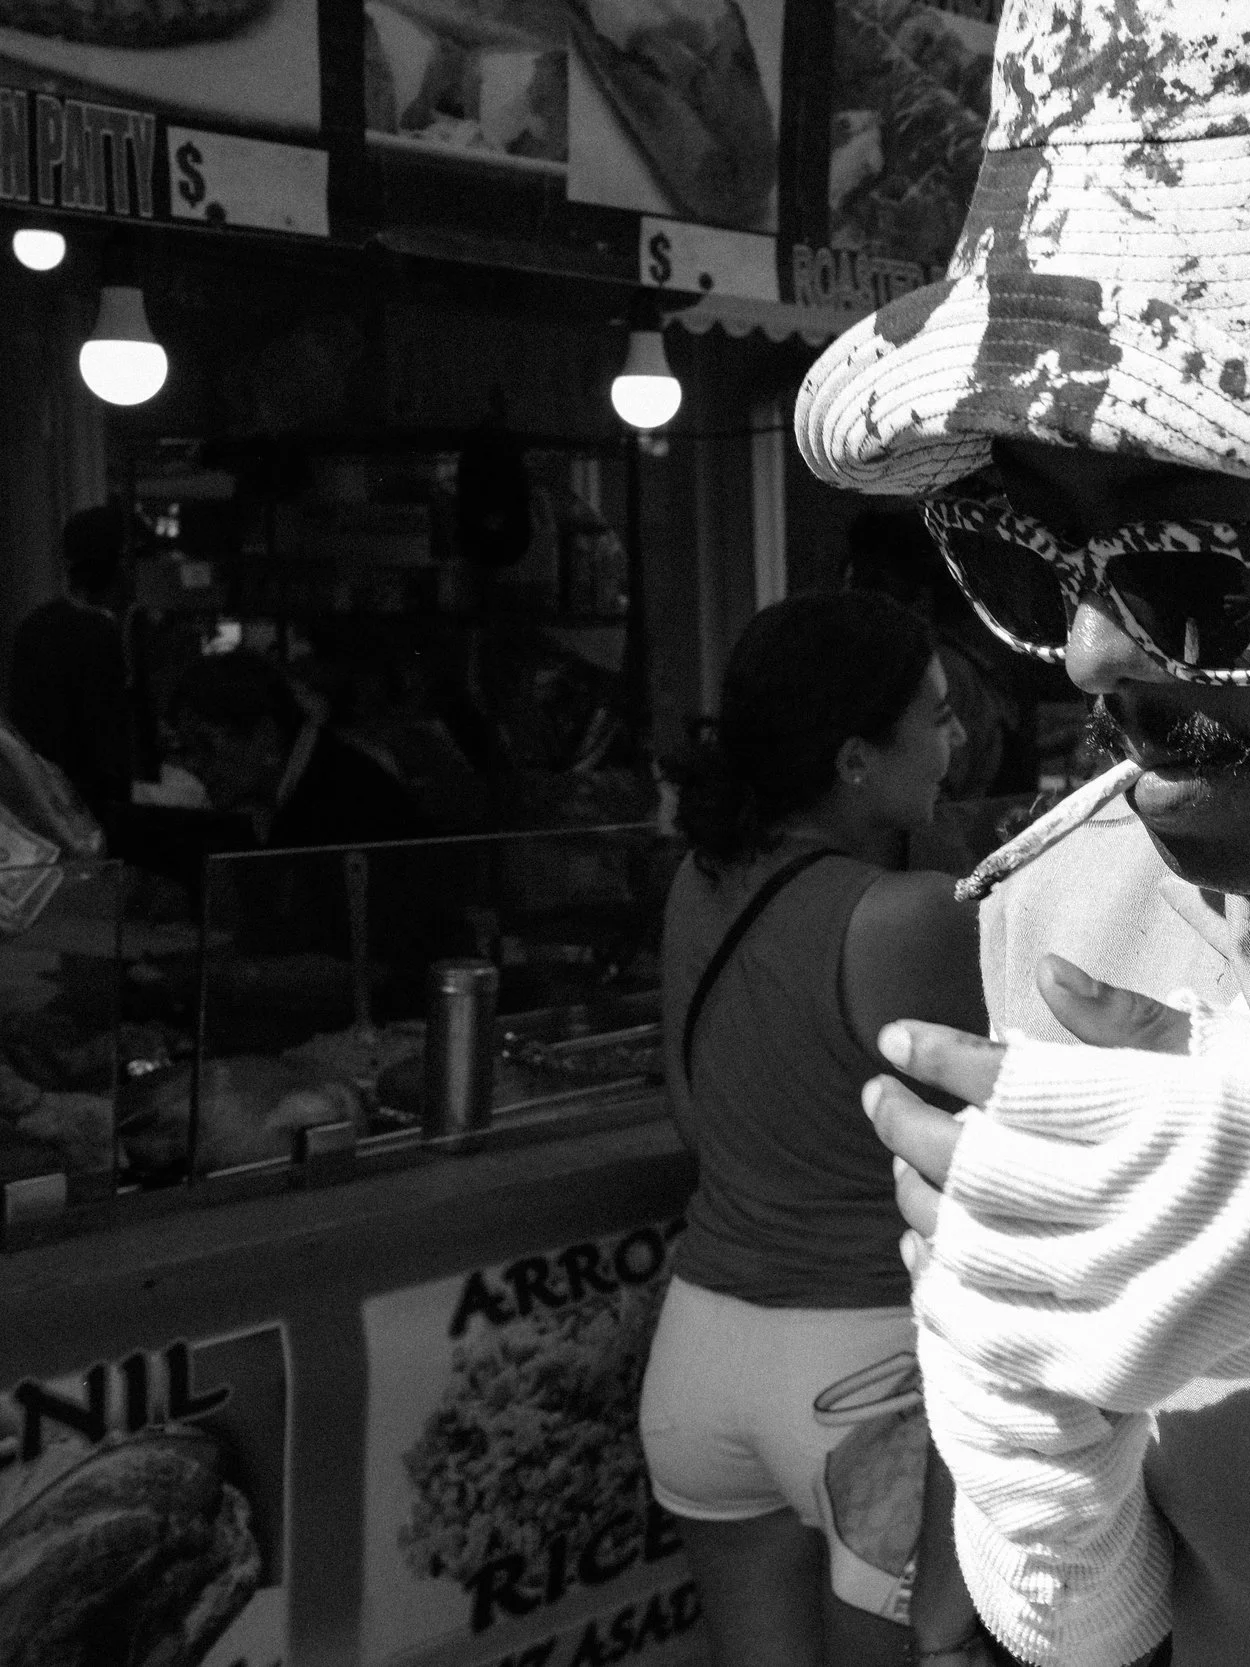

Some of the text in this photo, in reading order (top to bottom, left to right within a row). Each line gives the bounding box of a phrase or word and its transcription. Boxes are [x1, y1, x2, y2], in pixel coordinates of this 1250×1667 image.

[36, 92, 156, 218] PATTY
[449, 1217, 687, 1337] ARRO
[0, 1340, 230, 1472] NIL
[466, 1503, 684, 1633] RICE
